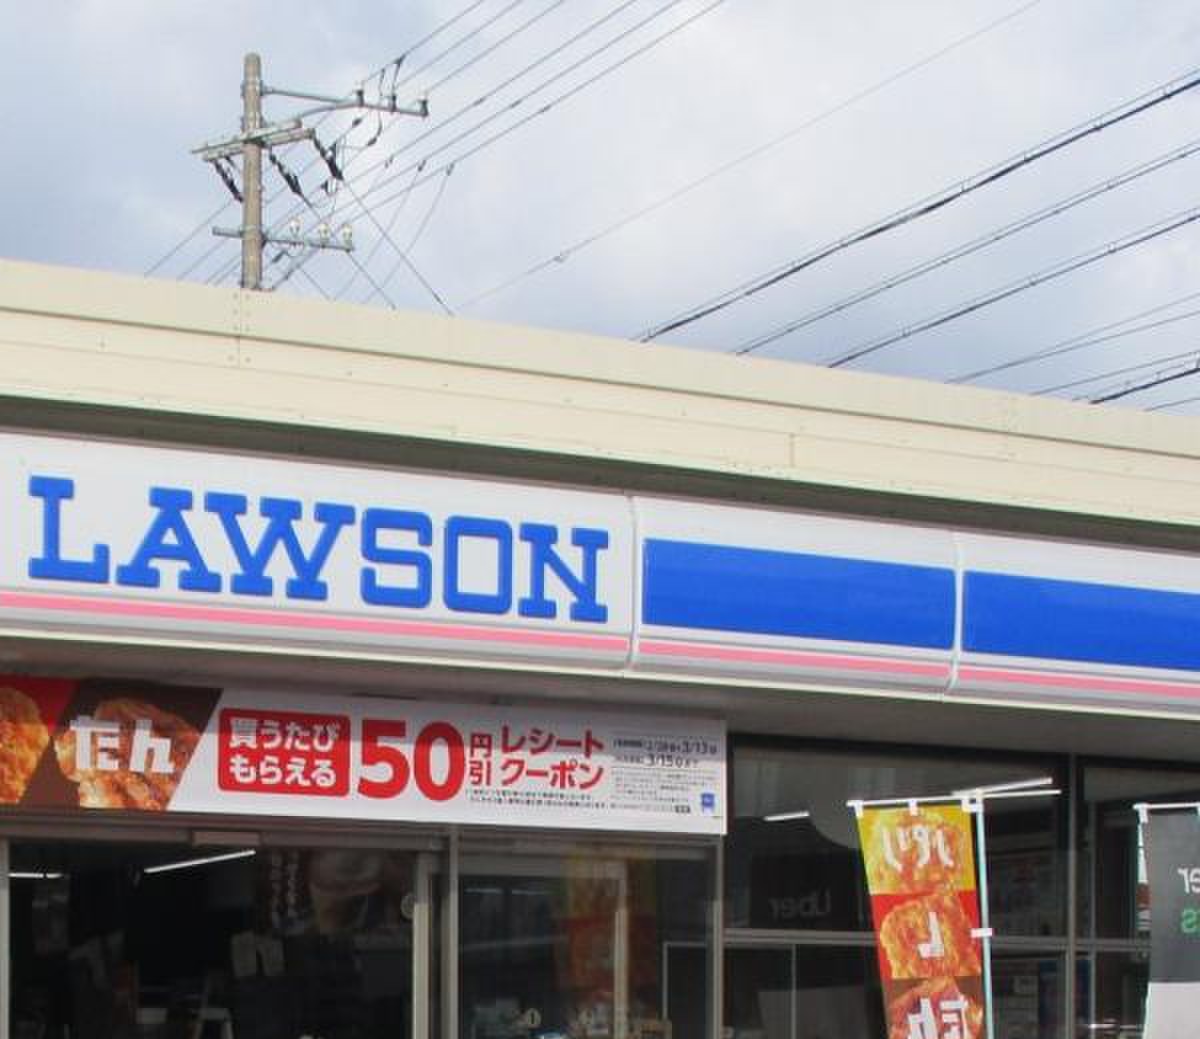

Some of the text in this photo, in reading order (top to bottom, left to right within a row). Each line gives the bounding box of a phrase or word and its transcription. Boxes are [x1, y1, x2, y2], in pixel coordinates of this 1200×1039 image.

[28, 475, 609, 623] LAWSON
[229, 717, 340, 752] 買うたび
[502, 726, 605, 758] レシート
[229, 754, 337, 787] もらえる
[357, 719, 465, 802] 50
[501, 758, 604, 790] クーポン
